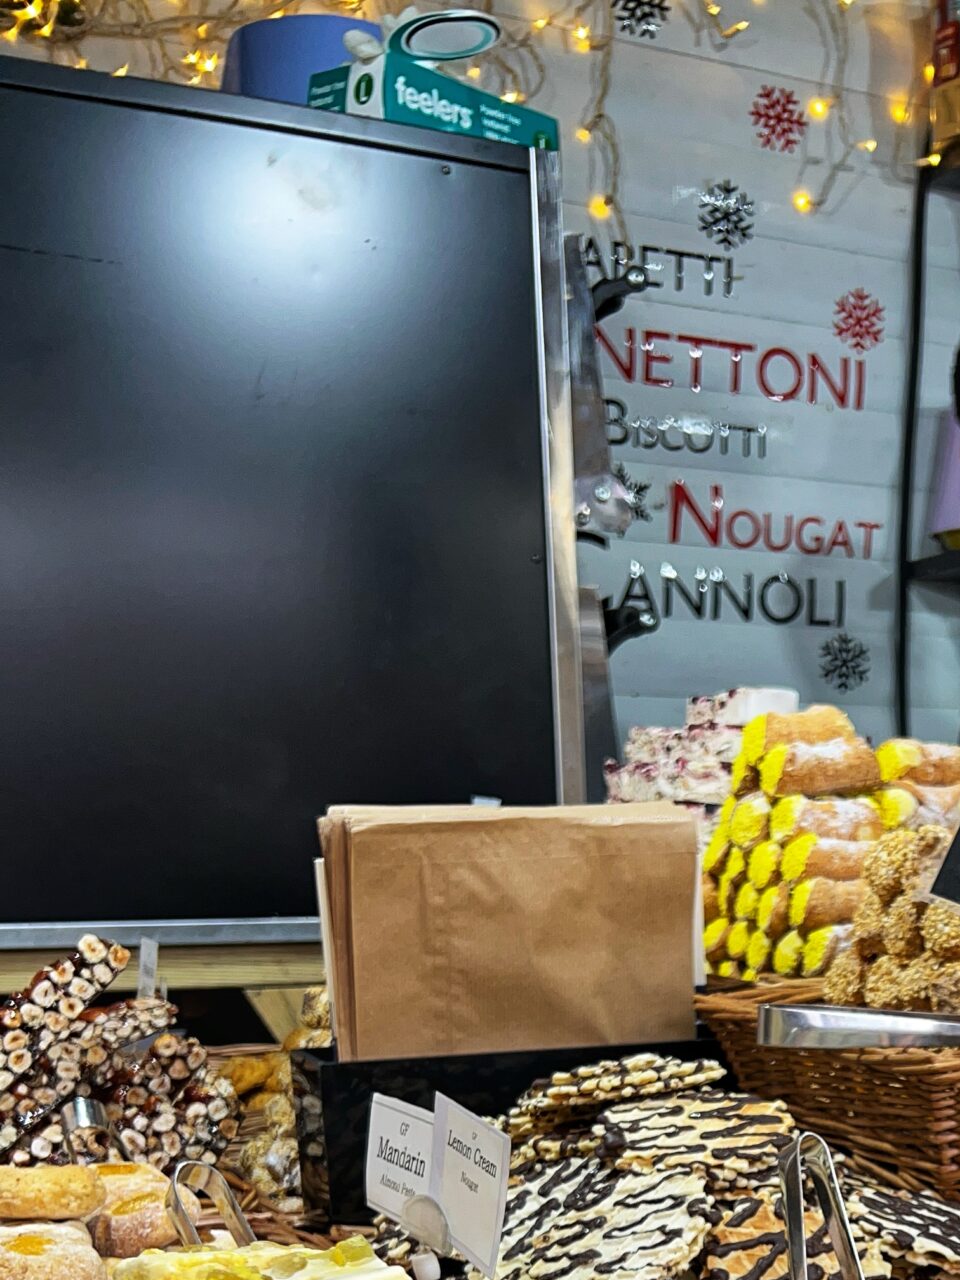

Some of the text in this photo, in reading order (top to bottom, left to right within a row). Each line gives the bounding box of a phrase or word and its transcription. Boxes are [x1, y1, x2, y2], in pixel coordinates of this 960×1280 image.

[394, 76, 475, 129] feelers
[668, 479, 884, 560] NOUGAT
[598, 548, 847, 628] ANNOLI
[377, 1136, 426, 1178] Mandarin
[448, 1130, 497, 1179] Lemon Cream
